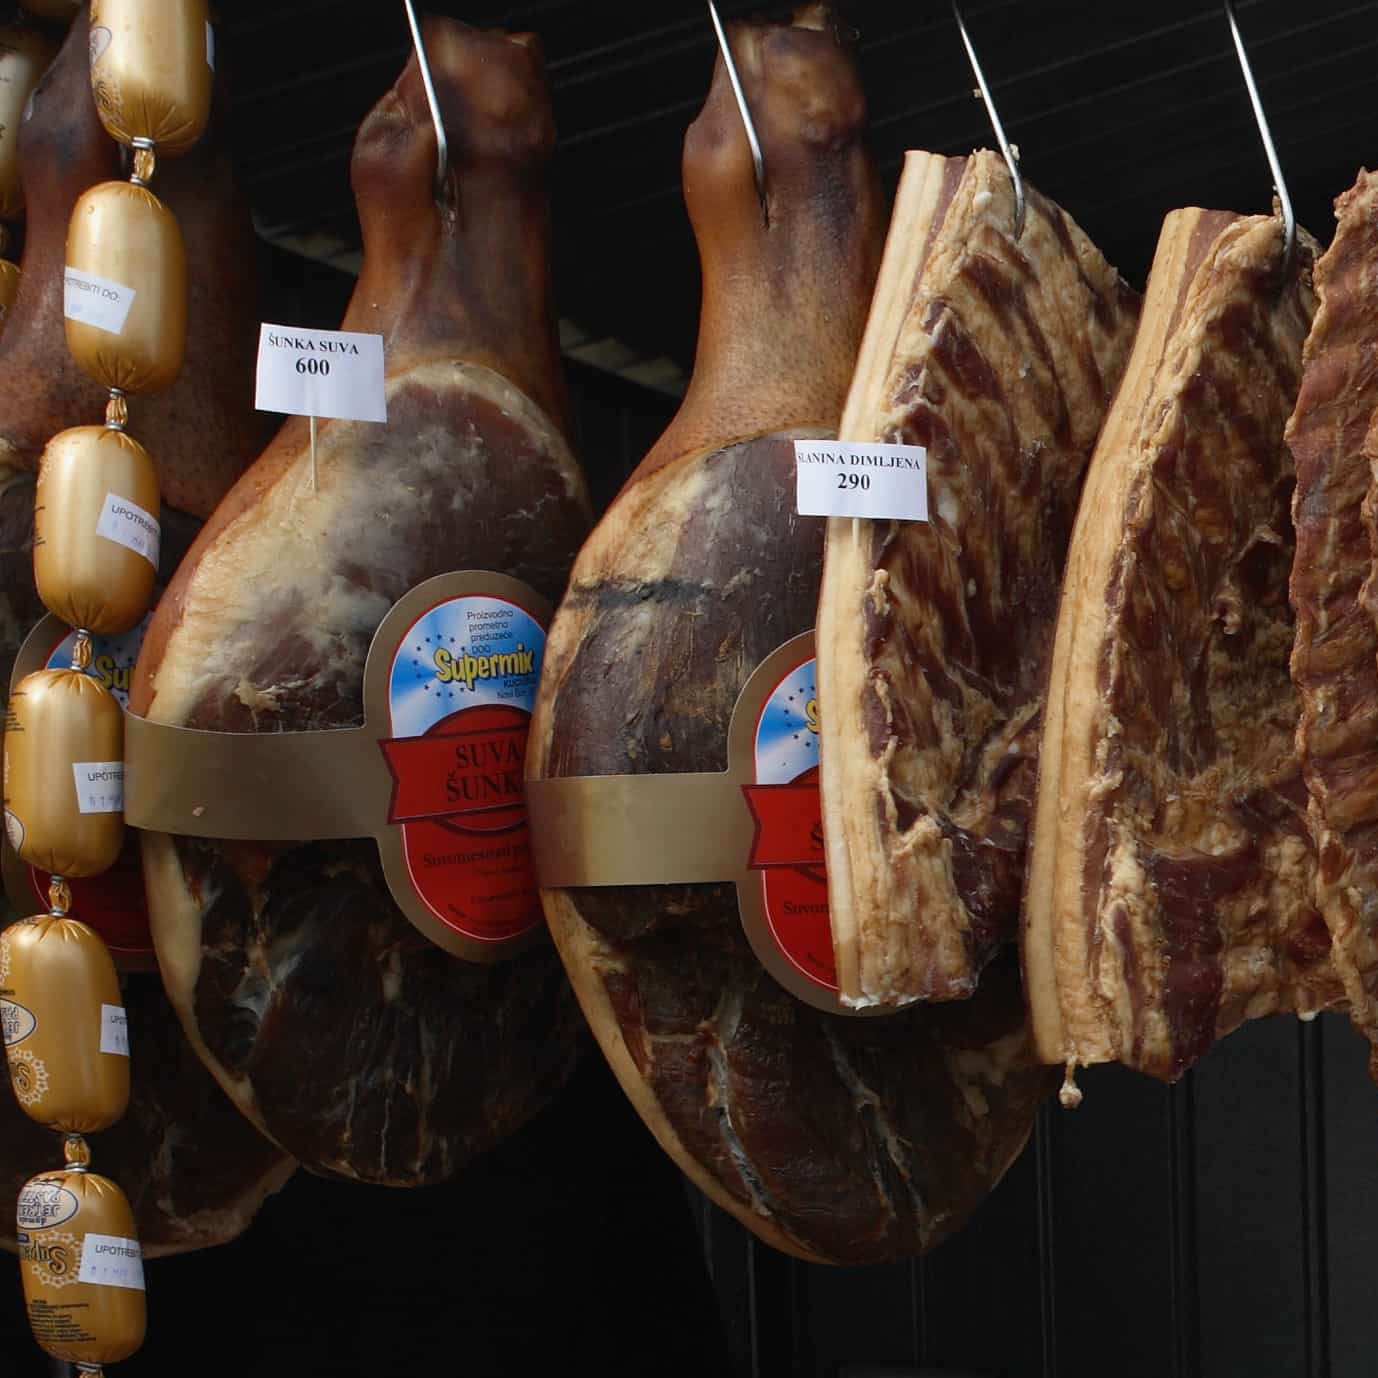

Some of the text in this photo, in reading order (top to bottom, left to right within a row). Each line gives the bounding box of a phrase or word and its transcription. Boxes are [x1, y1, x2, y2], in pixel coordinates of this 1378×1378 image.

[268, 333, 360, 355] ŠUNKA SUVA
[295, 357, 331, 377] 600
[850, 454, 921, 470] DIMLJENA
[837, 473, 871, 490] 290
[433, 643, 535, 693] Supermix
[455, 742, 522, 769] SUVA
